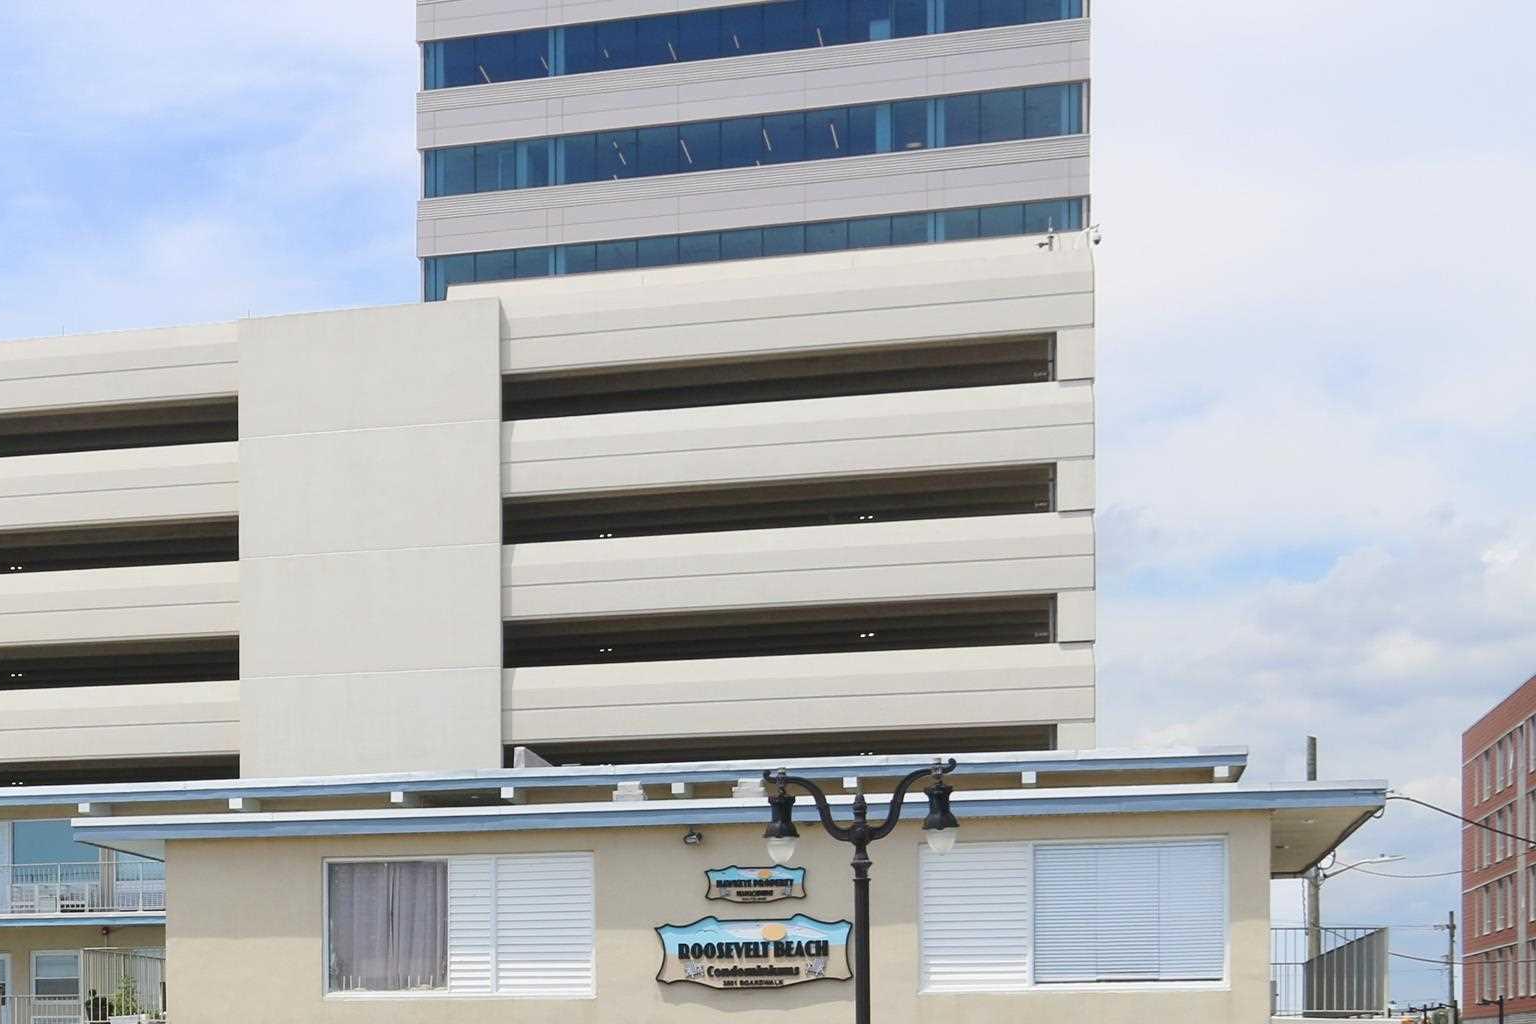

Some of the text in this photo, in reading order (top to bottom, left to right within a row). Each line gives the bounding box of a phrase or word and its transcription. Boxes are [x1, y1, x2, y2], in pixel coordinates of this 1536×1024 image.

[677, 940, 830, 960] ROOSEVELT BEACH
[706, 965, 800, 978] Condominiums
[739, 979, 784, 987] BOARDWALK
